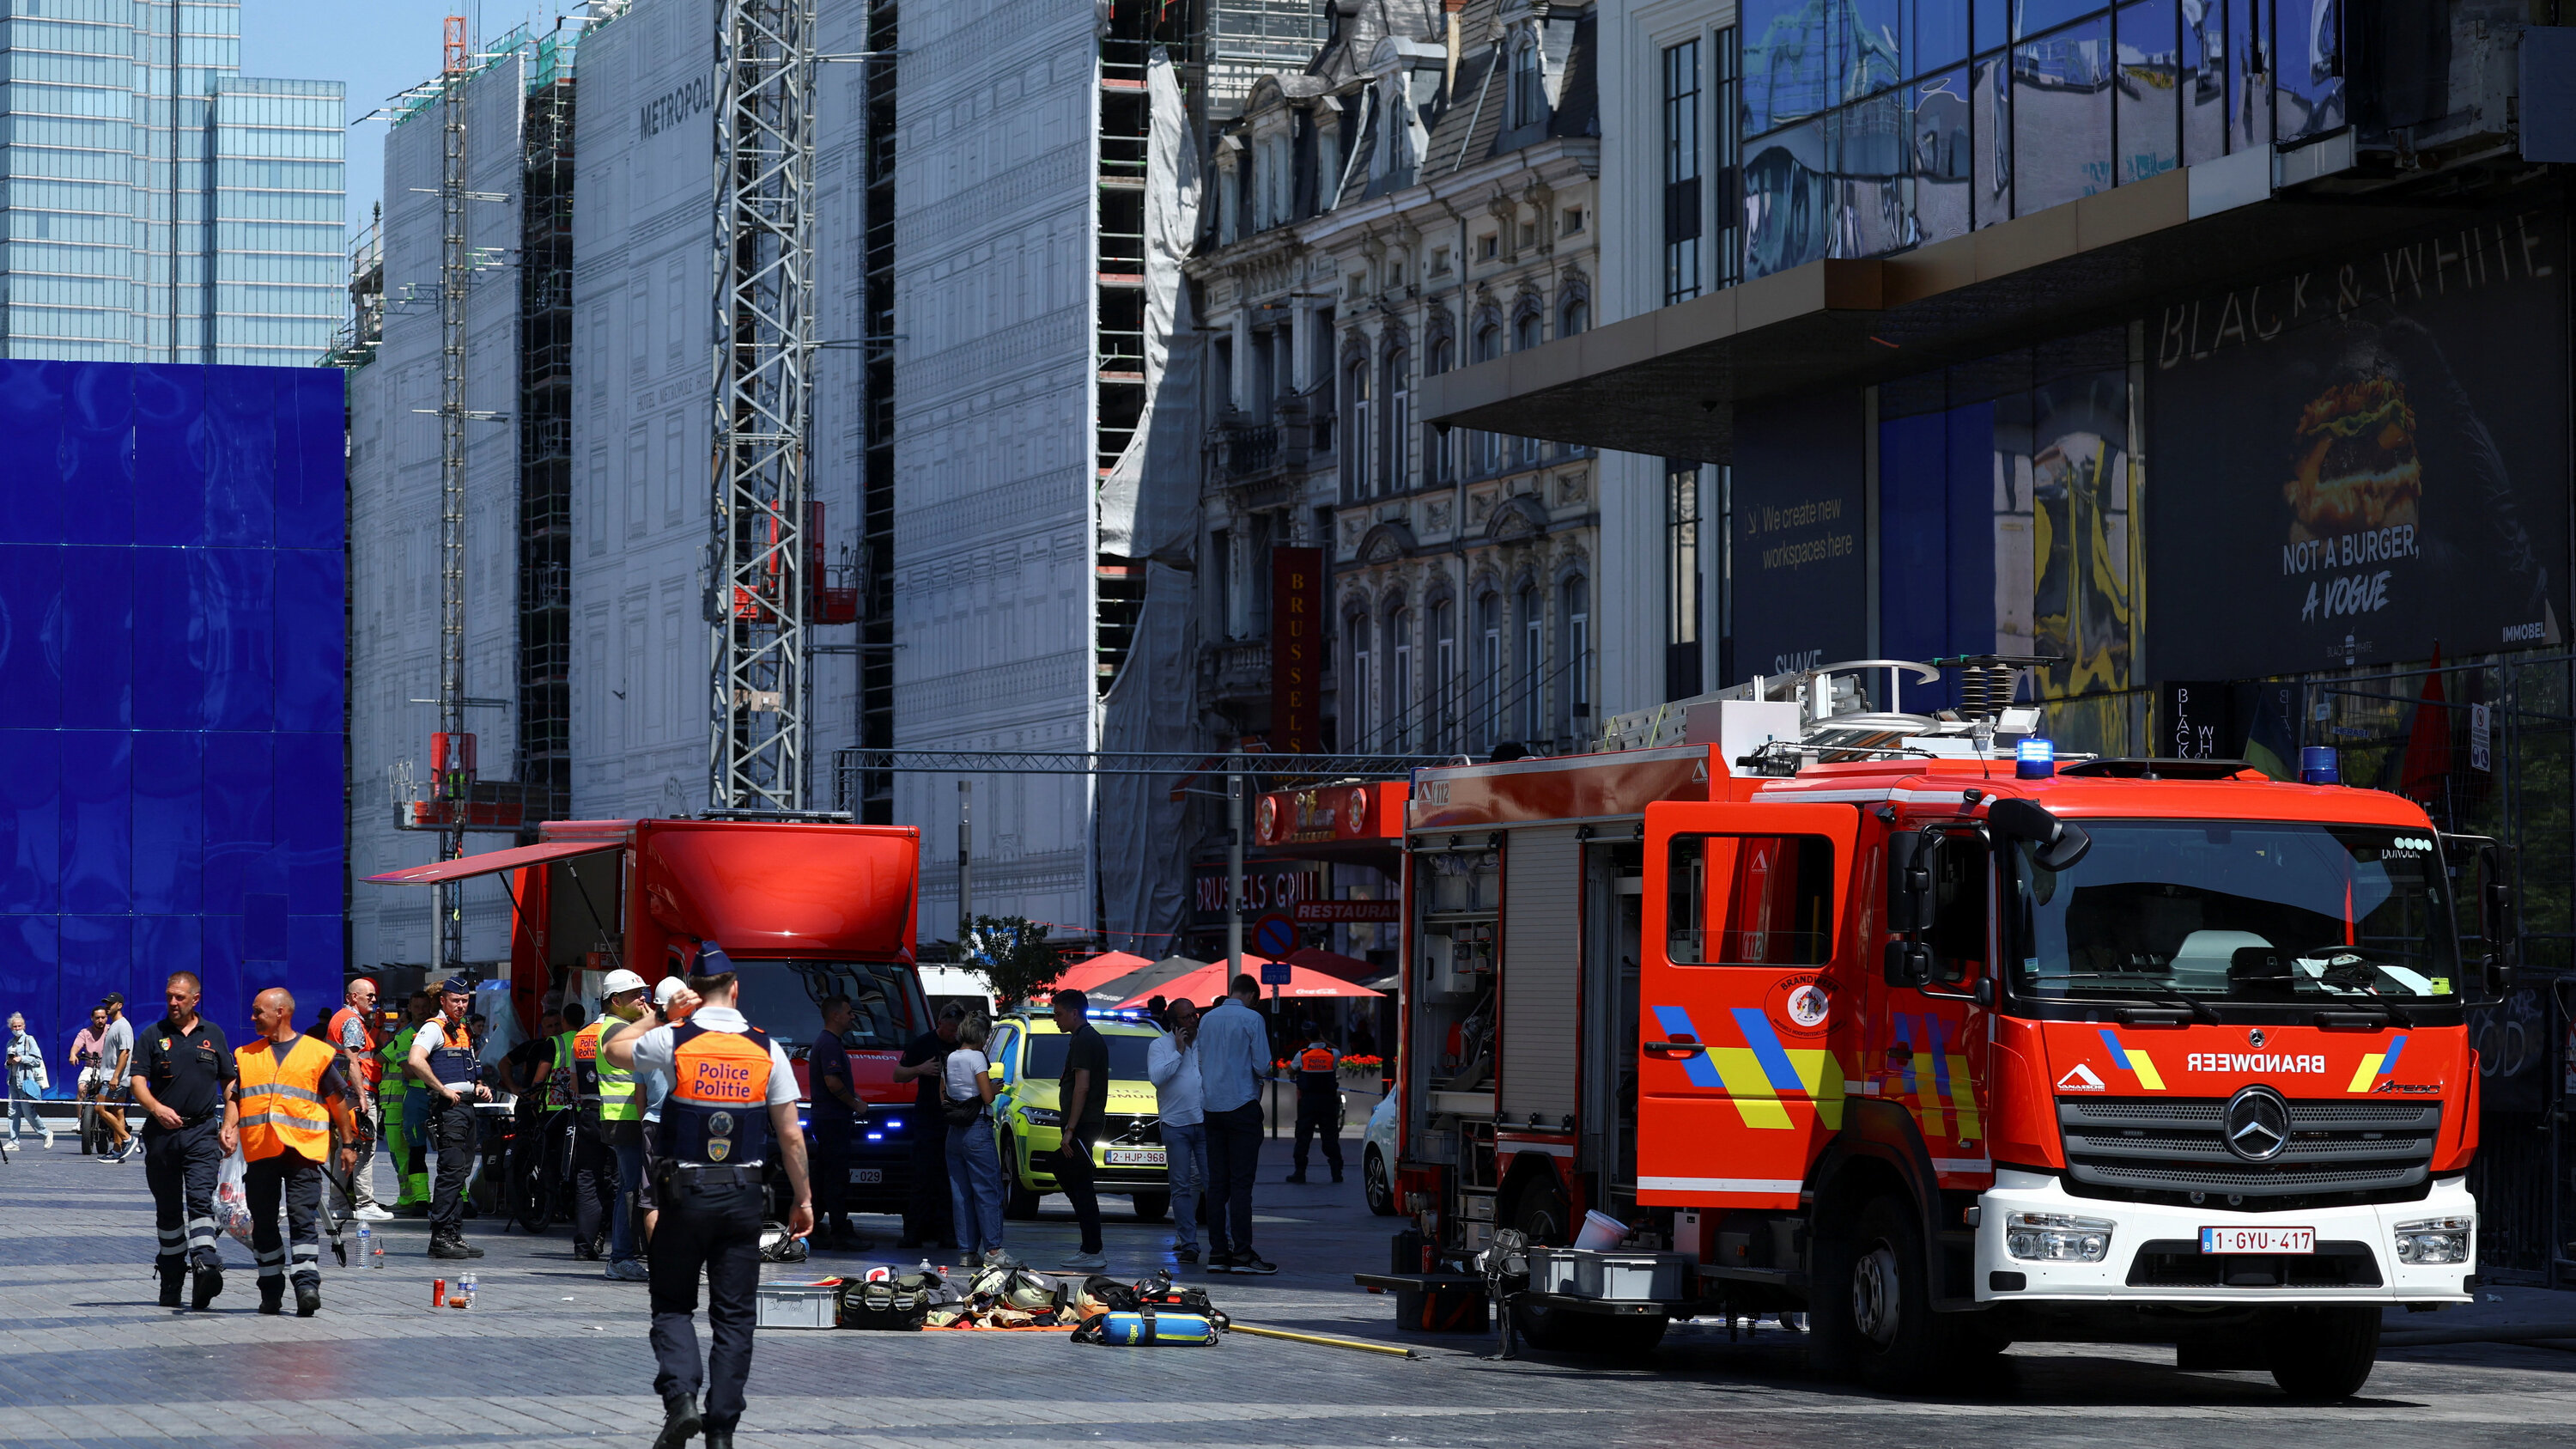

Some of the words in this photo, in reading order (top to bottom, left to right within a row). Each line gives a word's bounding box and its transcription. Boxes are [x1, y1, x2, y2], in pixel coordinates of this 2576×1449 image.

[2159, 272, 2311, 370] BLACK
[2337, 264, 2361, 322] &
[2383, 210, 2553, 306] WHITE
[1762, 505, 1781, 533] We
[1783, 499, 1817, 529] create
[1818, 498, 1842, 522] new
[1763, 540, 1826, 571] workspaces
[1827, 531, 1853, 557] here
[2283, 539, 2320, 575] NOT
[2324, 537, 2337, 569] A
[2342, 524, 2420, 560] BURGER,
[2301, 581, 2321, 626] A
[2324, 570, 2393, 619] VOGUE
[2501, 621, 2547, 643] IMMOBEL
[1291, 573, 1304, 754] BRUSSELS
[2176, 688, 2190, 759] BLACK
[1195, 874, 1267, 911] BRUSELS
[1297, 904, 1400, 918] RESTAURAN
[1780, 975, 1839, 992] BRANDWEER
[579, 1047, 596, 1057] Polit
[580, 1038, 597, 1048] Polic
[699, 1062, 749, 1081] Police
[695, 1080, 750, 1098] Politie
[1112, 1153, 1165, 1162] 2-HJP-968
[2204, 1241, 2211, 1250] B
[2215, 1232, 2312, 1250] 1-GYU-417
